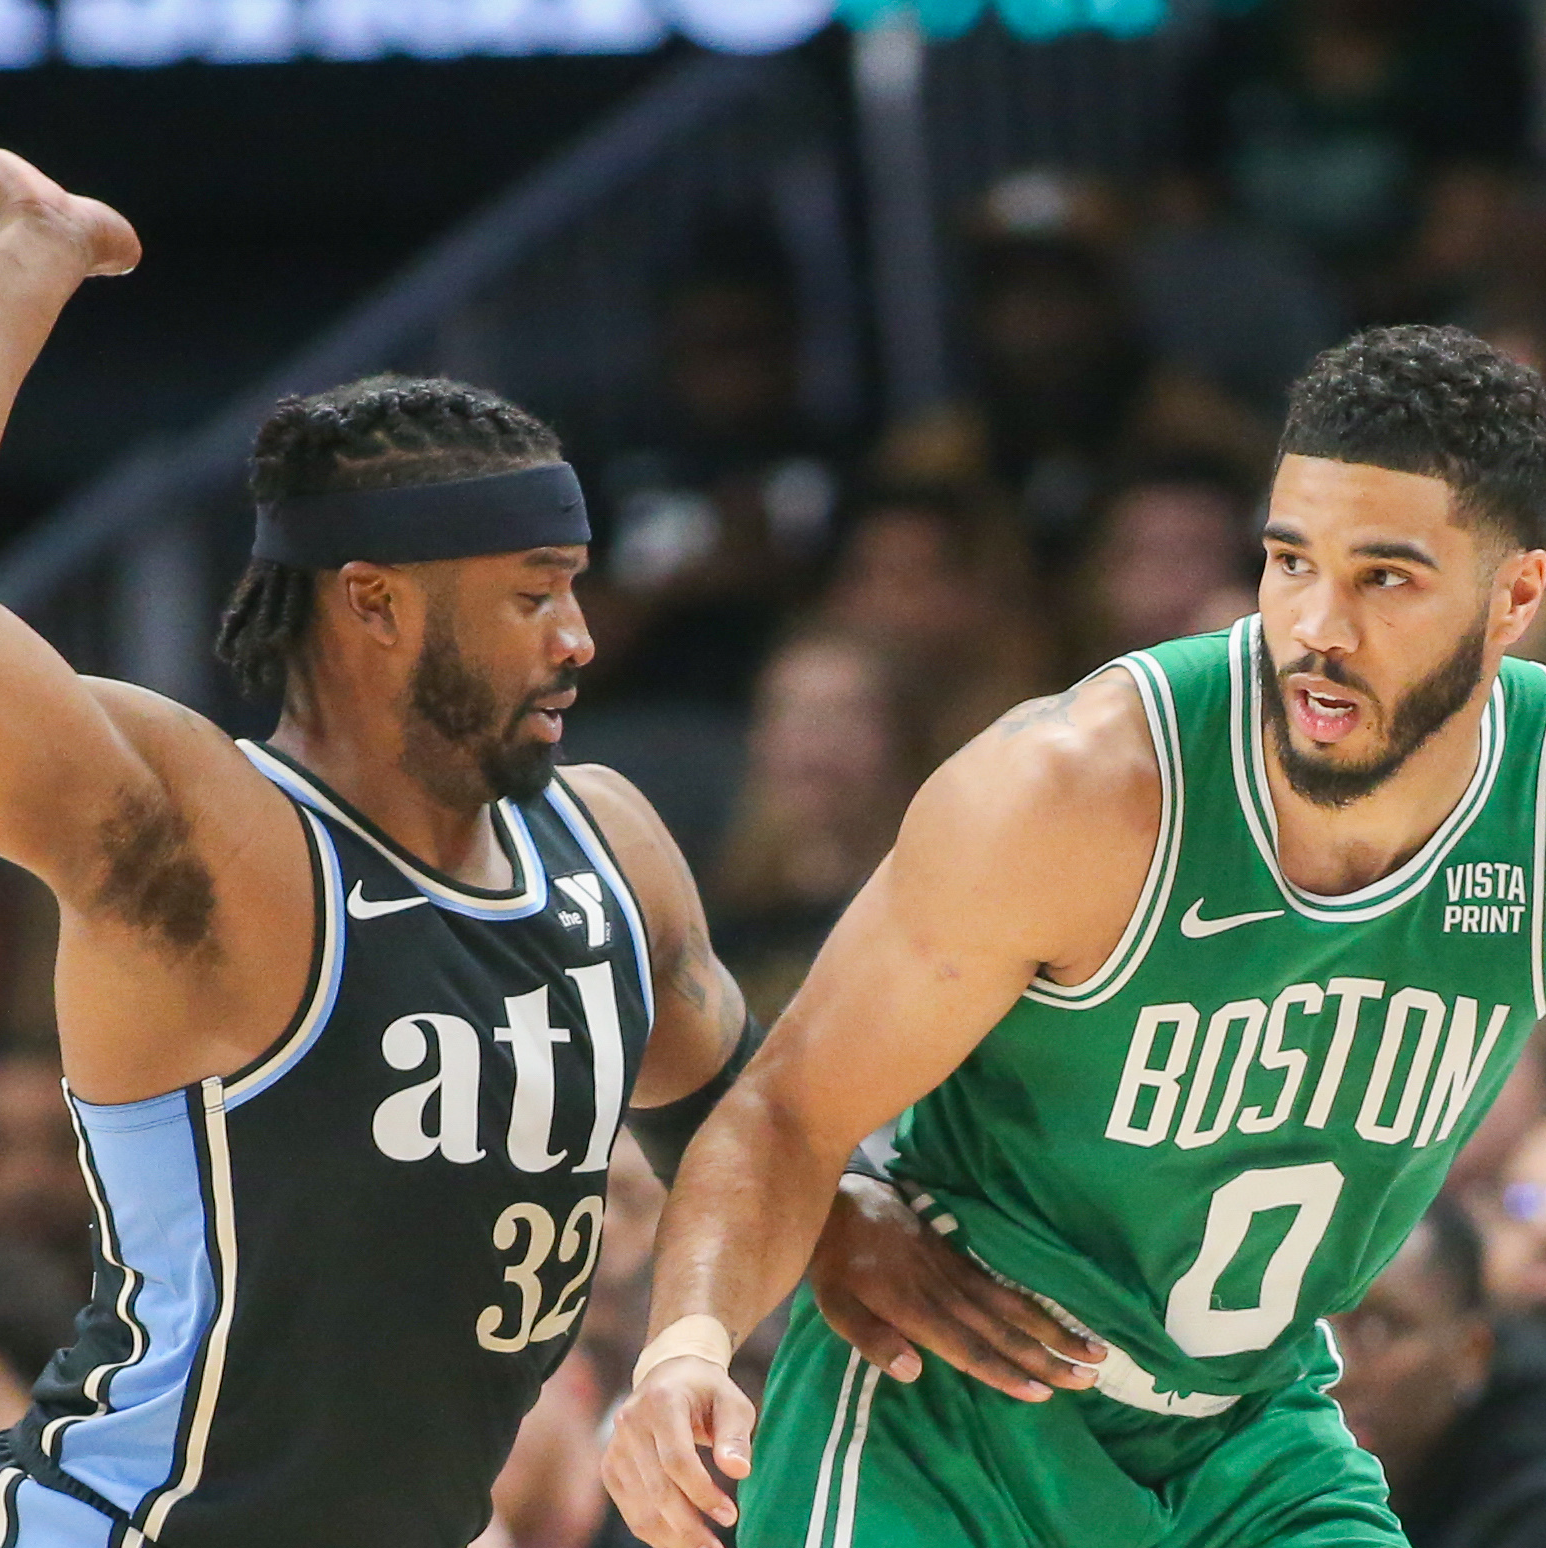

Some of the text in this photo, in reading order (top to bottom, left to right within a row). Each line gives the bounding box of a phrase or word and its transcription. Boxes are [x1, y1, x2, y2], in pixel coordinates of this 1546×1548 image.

[553, 872, 604, 947] the Y
[1443, 905, 1525, 933] PRINT
[1446, 862, 1526, 903] VISTA
[372, 961, 624, 1173] atl
[1104, 976, 1510, 1150] BOSTON
[475, 1195, 603, 1353] 32
[1165, 1161, 1345, 1358] 0
